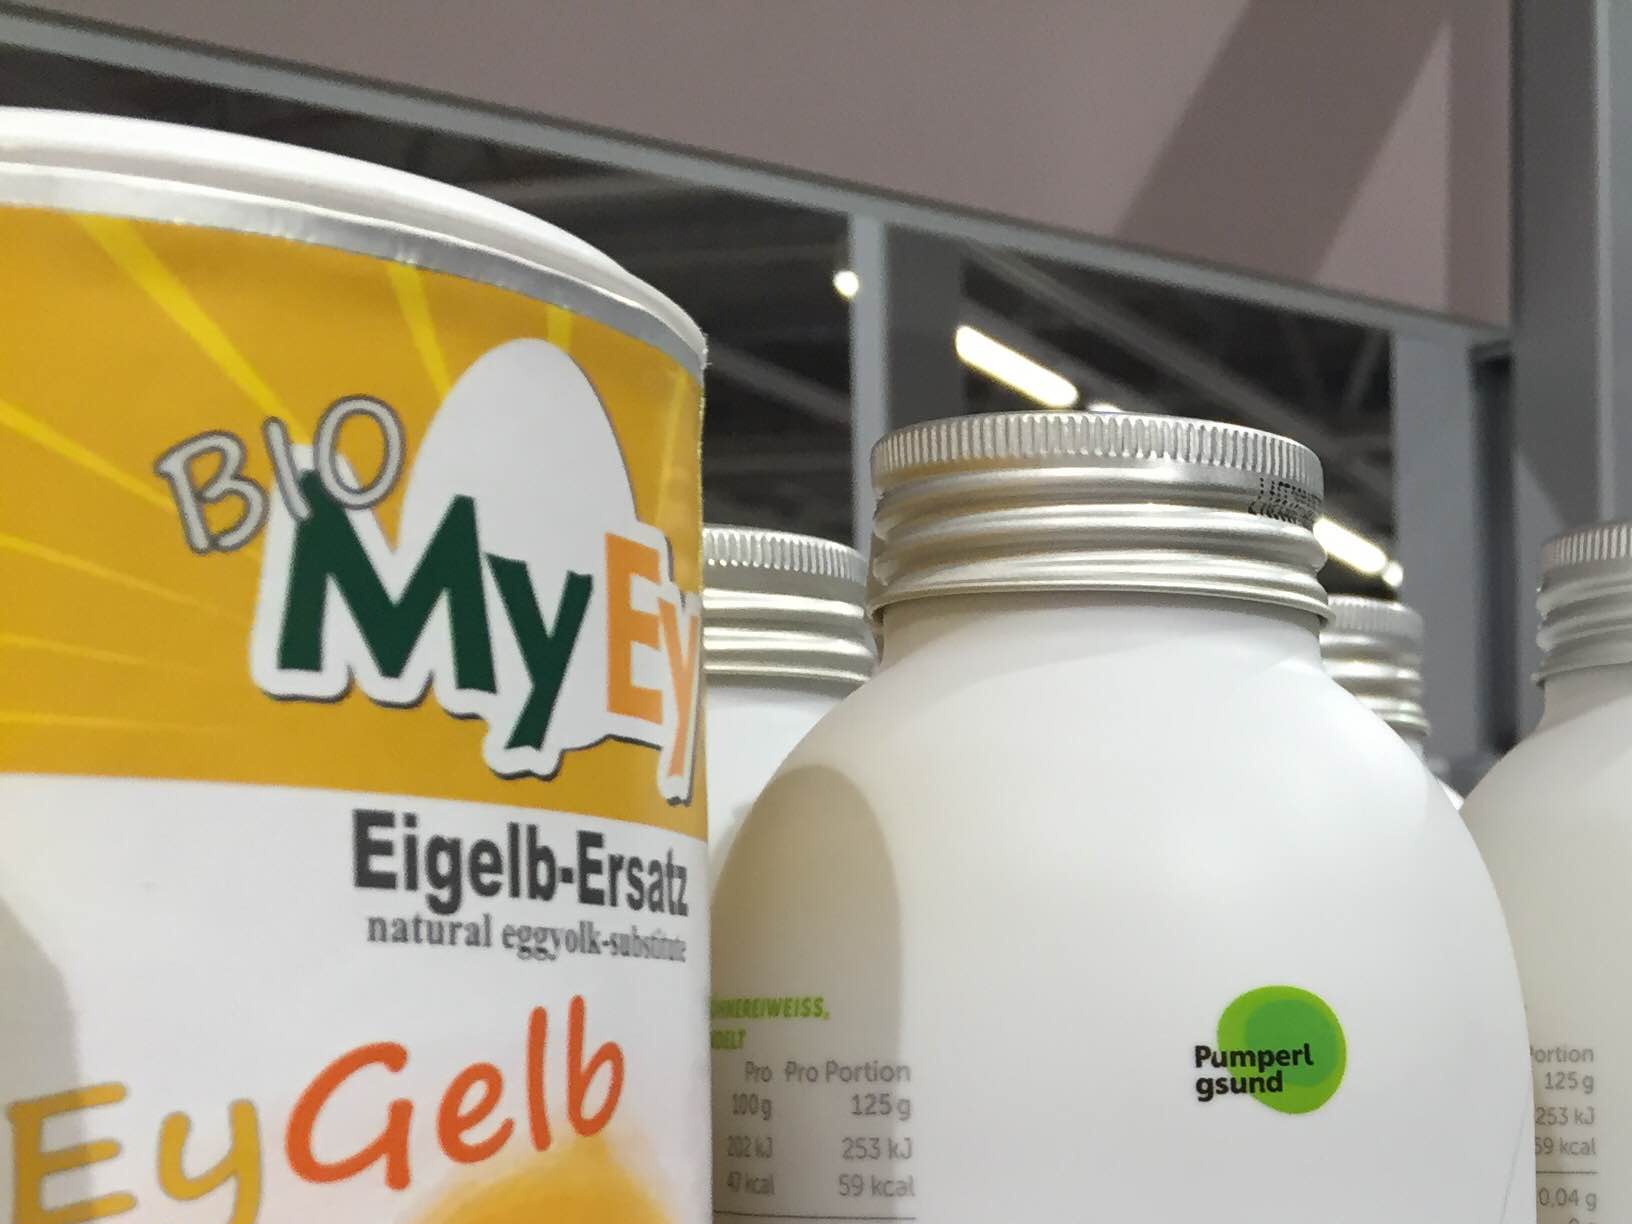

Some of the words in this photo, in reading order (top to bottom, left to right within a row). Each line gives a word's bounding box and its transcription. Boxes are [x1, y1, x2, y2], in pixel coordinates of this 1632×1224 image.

[155, 394, 404, 555] BIO
[276, 467, 700, 780] MyEy
[353, 808, 690, 918] Eigelb-Ersatz
[367, 912, 492, 948] natural
[784, 1060, 819, 1083] Pro
[826, 1059, 912, 1083] Portion
[1194, 1043, 1314, 1073] Pumperl
[1195, 1070, 1284, 1102] gsund
[1544, 1071, 1579, 1091] 125
[1582, 1075, 1595, 1095] g
[852, 1093, 892, 1116] 125
[897, 1097, 912, 1121] g
[1535, 1105, 1569, 1126] 253
[1574, 1106, 1595, 1126] kJ
[842, 1137, 880, 1160] 253
[888, 1137, 913, 1160] kJ
[1559, 1136, 1597, 1157] kcal
[839, 1173, 864, 1196] 59
[871, 1174, 916, 1197] kcal
[1585, 1192, 1597, 1212] g
